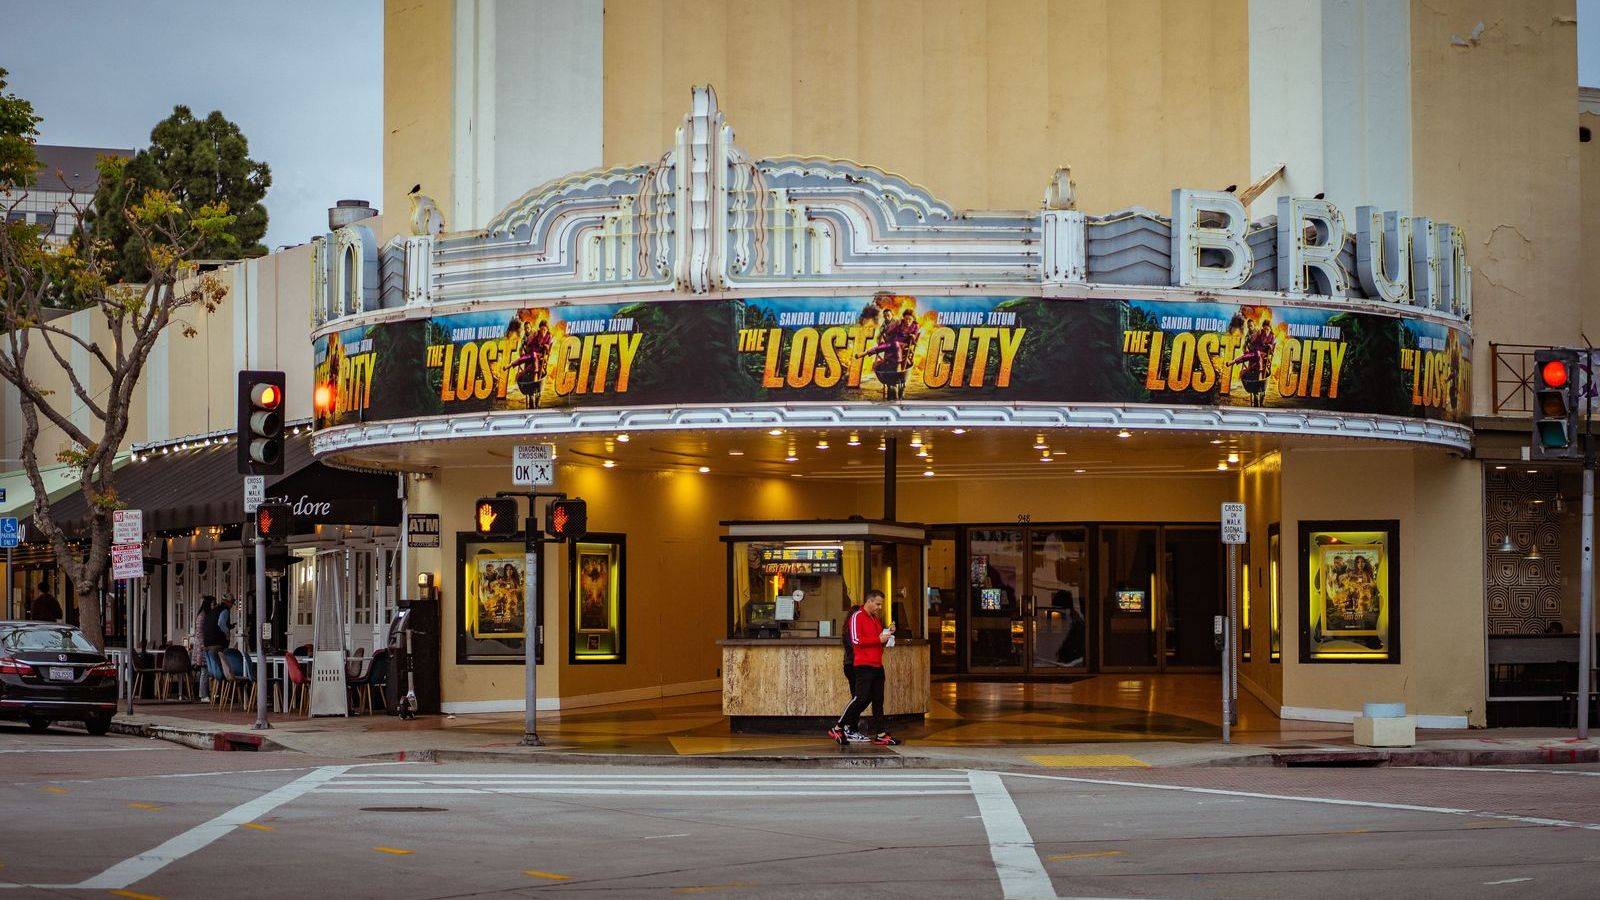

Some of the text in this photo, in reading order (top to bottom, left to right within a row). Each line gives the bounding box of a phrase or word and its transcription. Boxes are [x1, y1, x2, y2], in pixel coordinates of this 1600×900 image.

[565, 317, 634, 334] CHANNING TATUM
[780, 311, 857, 326] SANDRA BULLOCK
[936, 311, 1017, 326] CHANNING TATUM
[1161, 316, 1192, 330] SANDRA
[451, 327, 476, 342] SANDRA
[1287, 323, 1341, 339] CHANNING TATUM
[738, 325, 1027, 389] THE LOST CITY
[1123, 330, 1348, 399] THE LOST CITY
[1400, 348, 1413, 371] THE
[426, 332, 643, 402] THE LOST CITY
[339, 352, 378, 414] CITY
[518, 445, 548, 453] DIAGONAL
[518, 452, 548, 460] CROSSING
[515, 465, 530, 480] OK
[1224, 504, 1243, 512] CROSS
[114, 512, 123, 521] NO
[1226, 518, 1241, 526] WALK
[408, 518, 439, 532] ATM
[1223, 526, 1244, 534] SIGNAL
[1226, 533, 1241, 541] ONLY
[112, 554, 123, 563] NO
